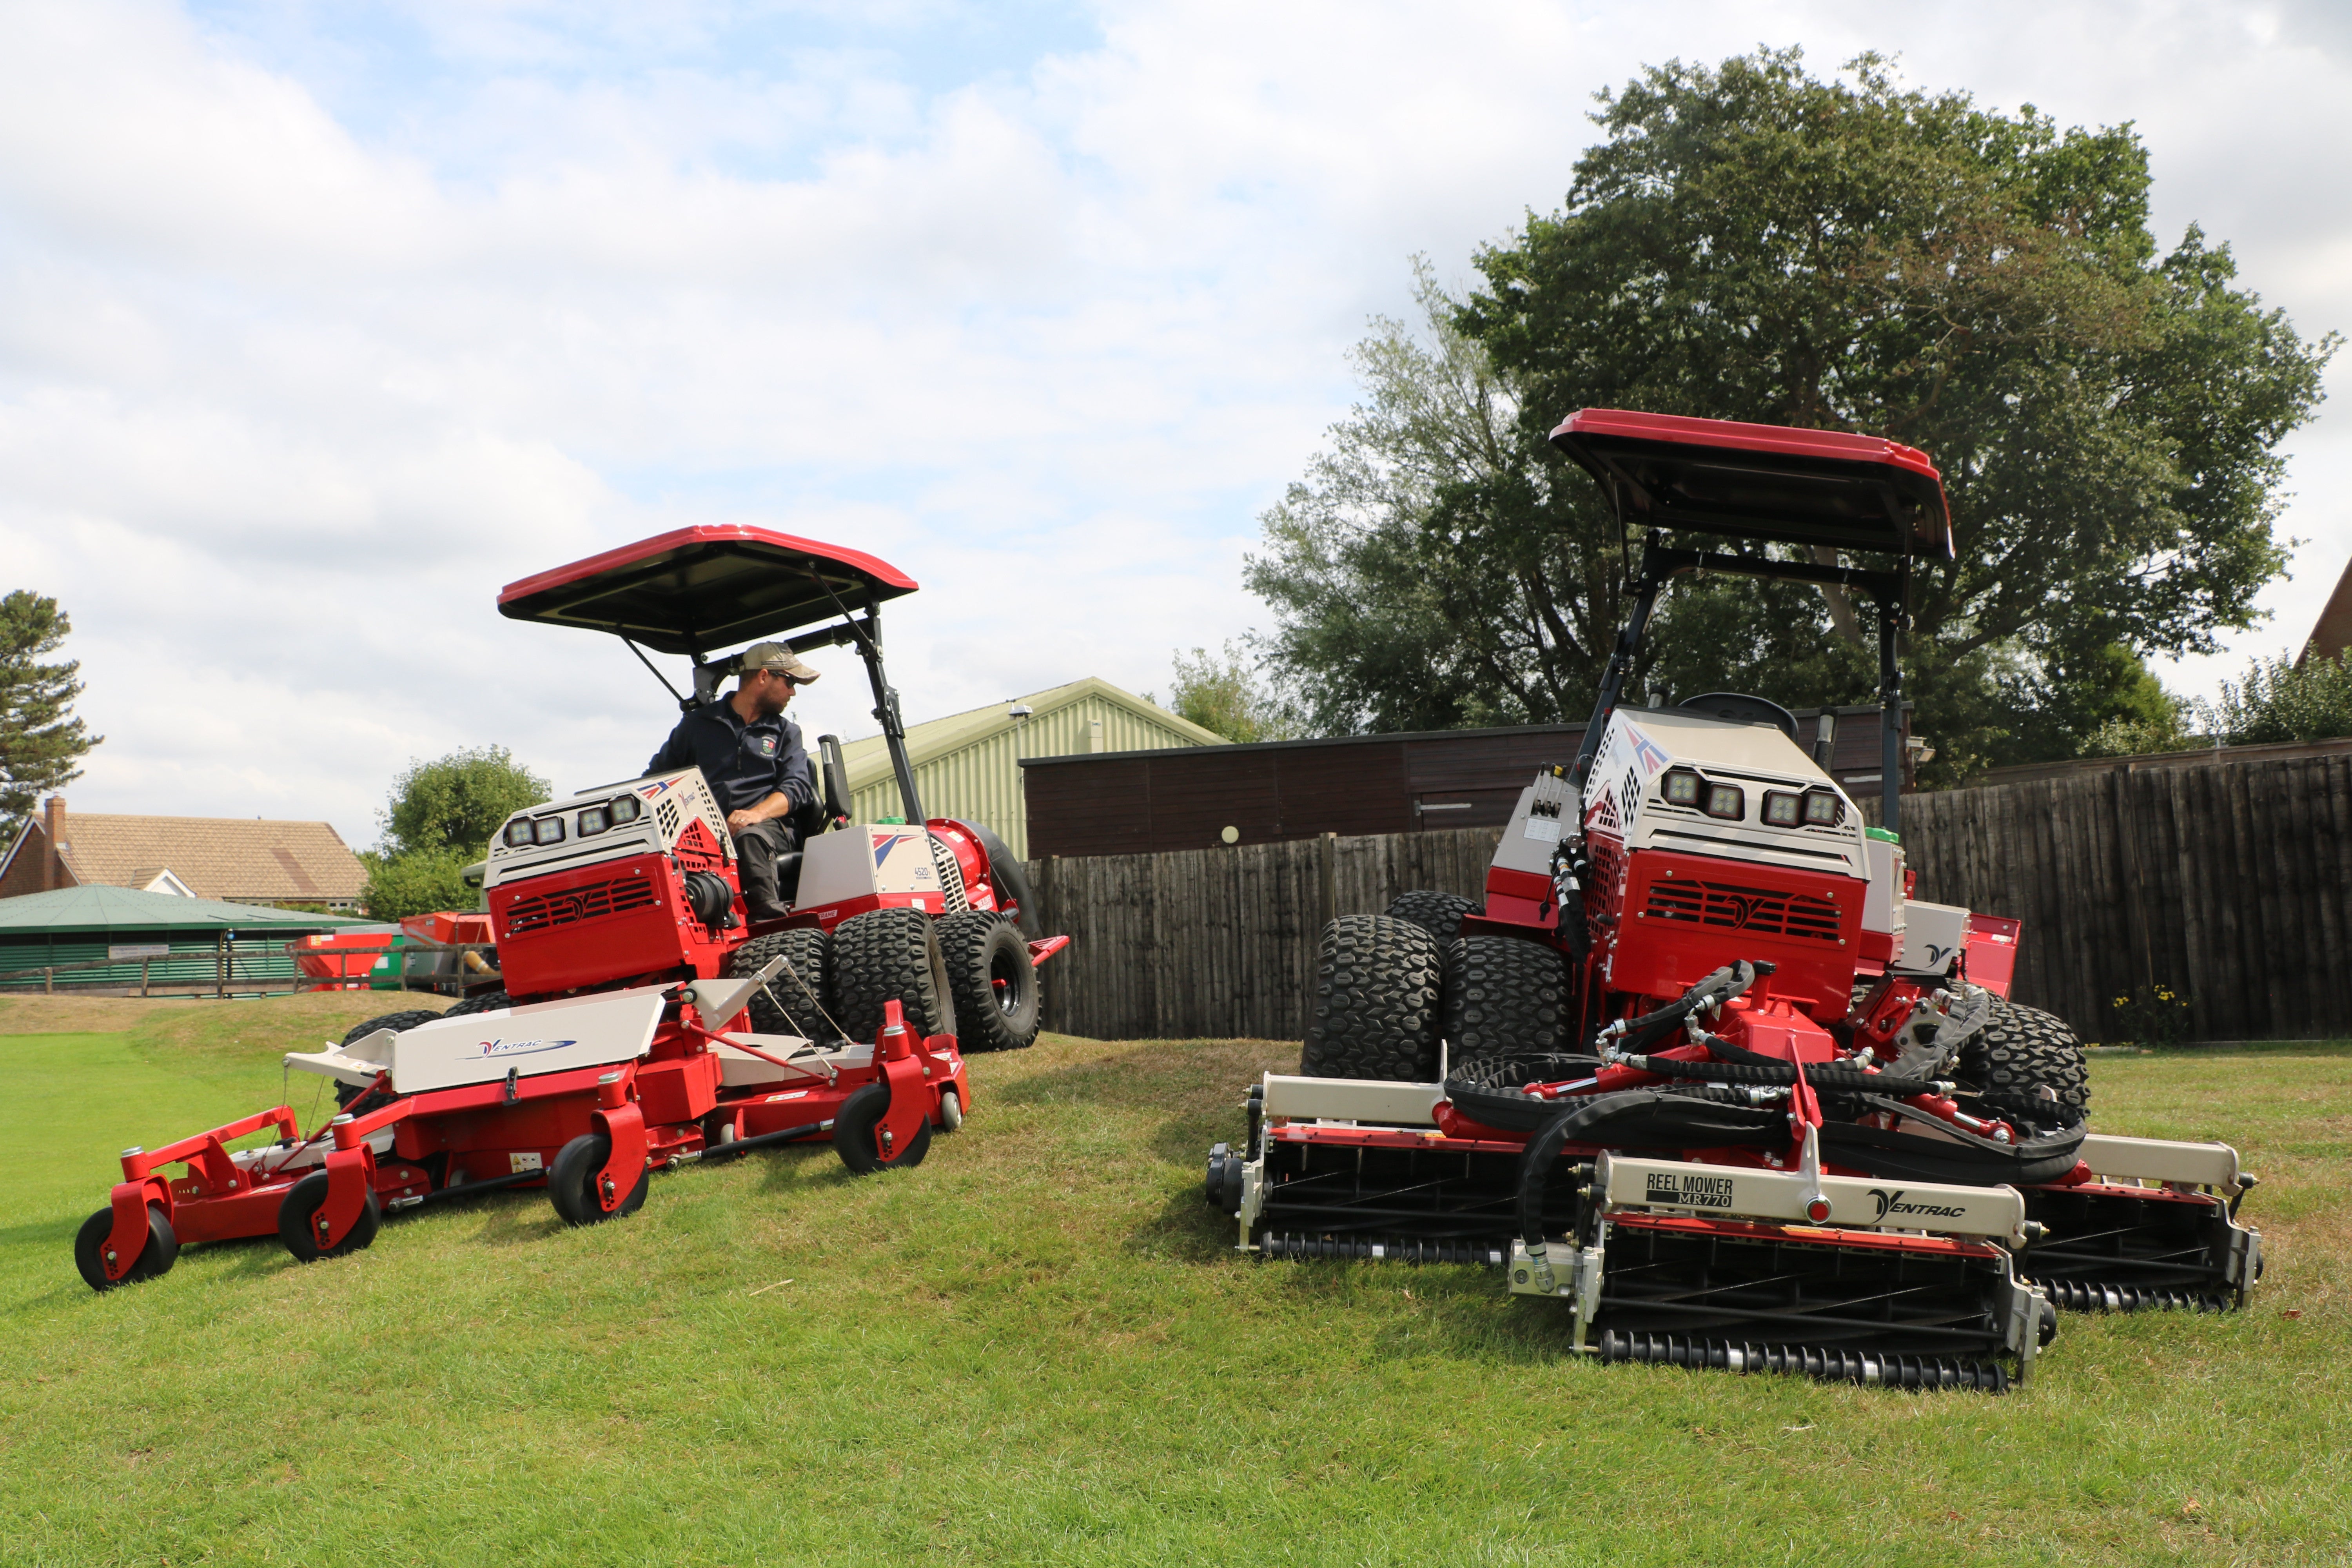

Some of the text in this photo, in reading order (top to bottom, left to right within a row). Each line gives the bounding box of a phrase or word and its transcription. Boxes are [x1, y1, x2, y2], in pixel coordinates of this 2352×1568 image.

[477, 1039, 542, 1059] VENTRAC
[1647, 1173, 1733, 1195] REEL MOWER
[1678, 1193, 1729, 1207] MR770
[1866, 1189, 1965, 1224] VENTRAC
